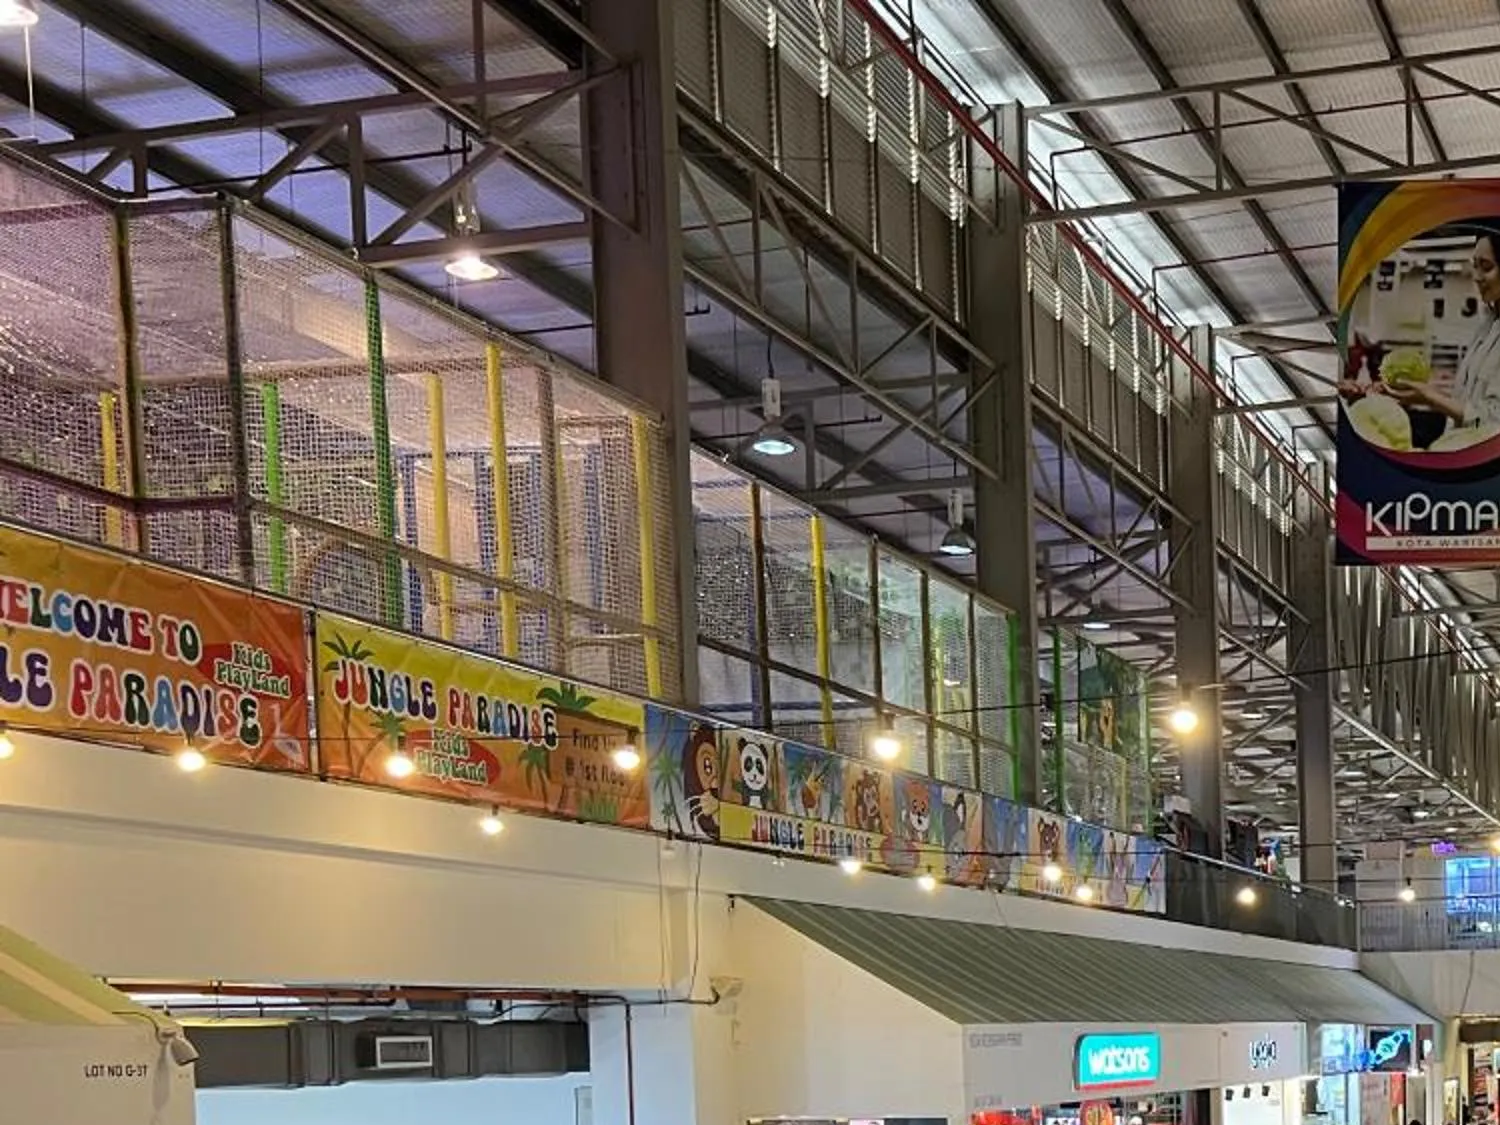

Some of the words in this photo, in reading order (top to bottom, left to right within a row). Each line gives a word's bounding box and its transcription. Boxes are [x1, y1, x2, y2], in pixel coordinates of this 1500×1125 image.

[158, 613, 201, 665] TO
[232, 641, 272, 671] Kids
[70, 661, 262, 747] PARADISE
[333, 658, 438, 722] JUNGLE
[447, 686, 560, 750] PARADISE
[83, 1064, 104, 1078] LOT
[107, 1064, 122, 1077] NO
[1087, 1045, 1152, 1076] watsons
